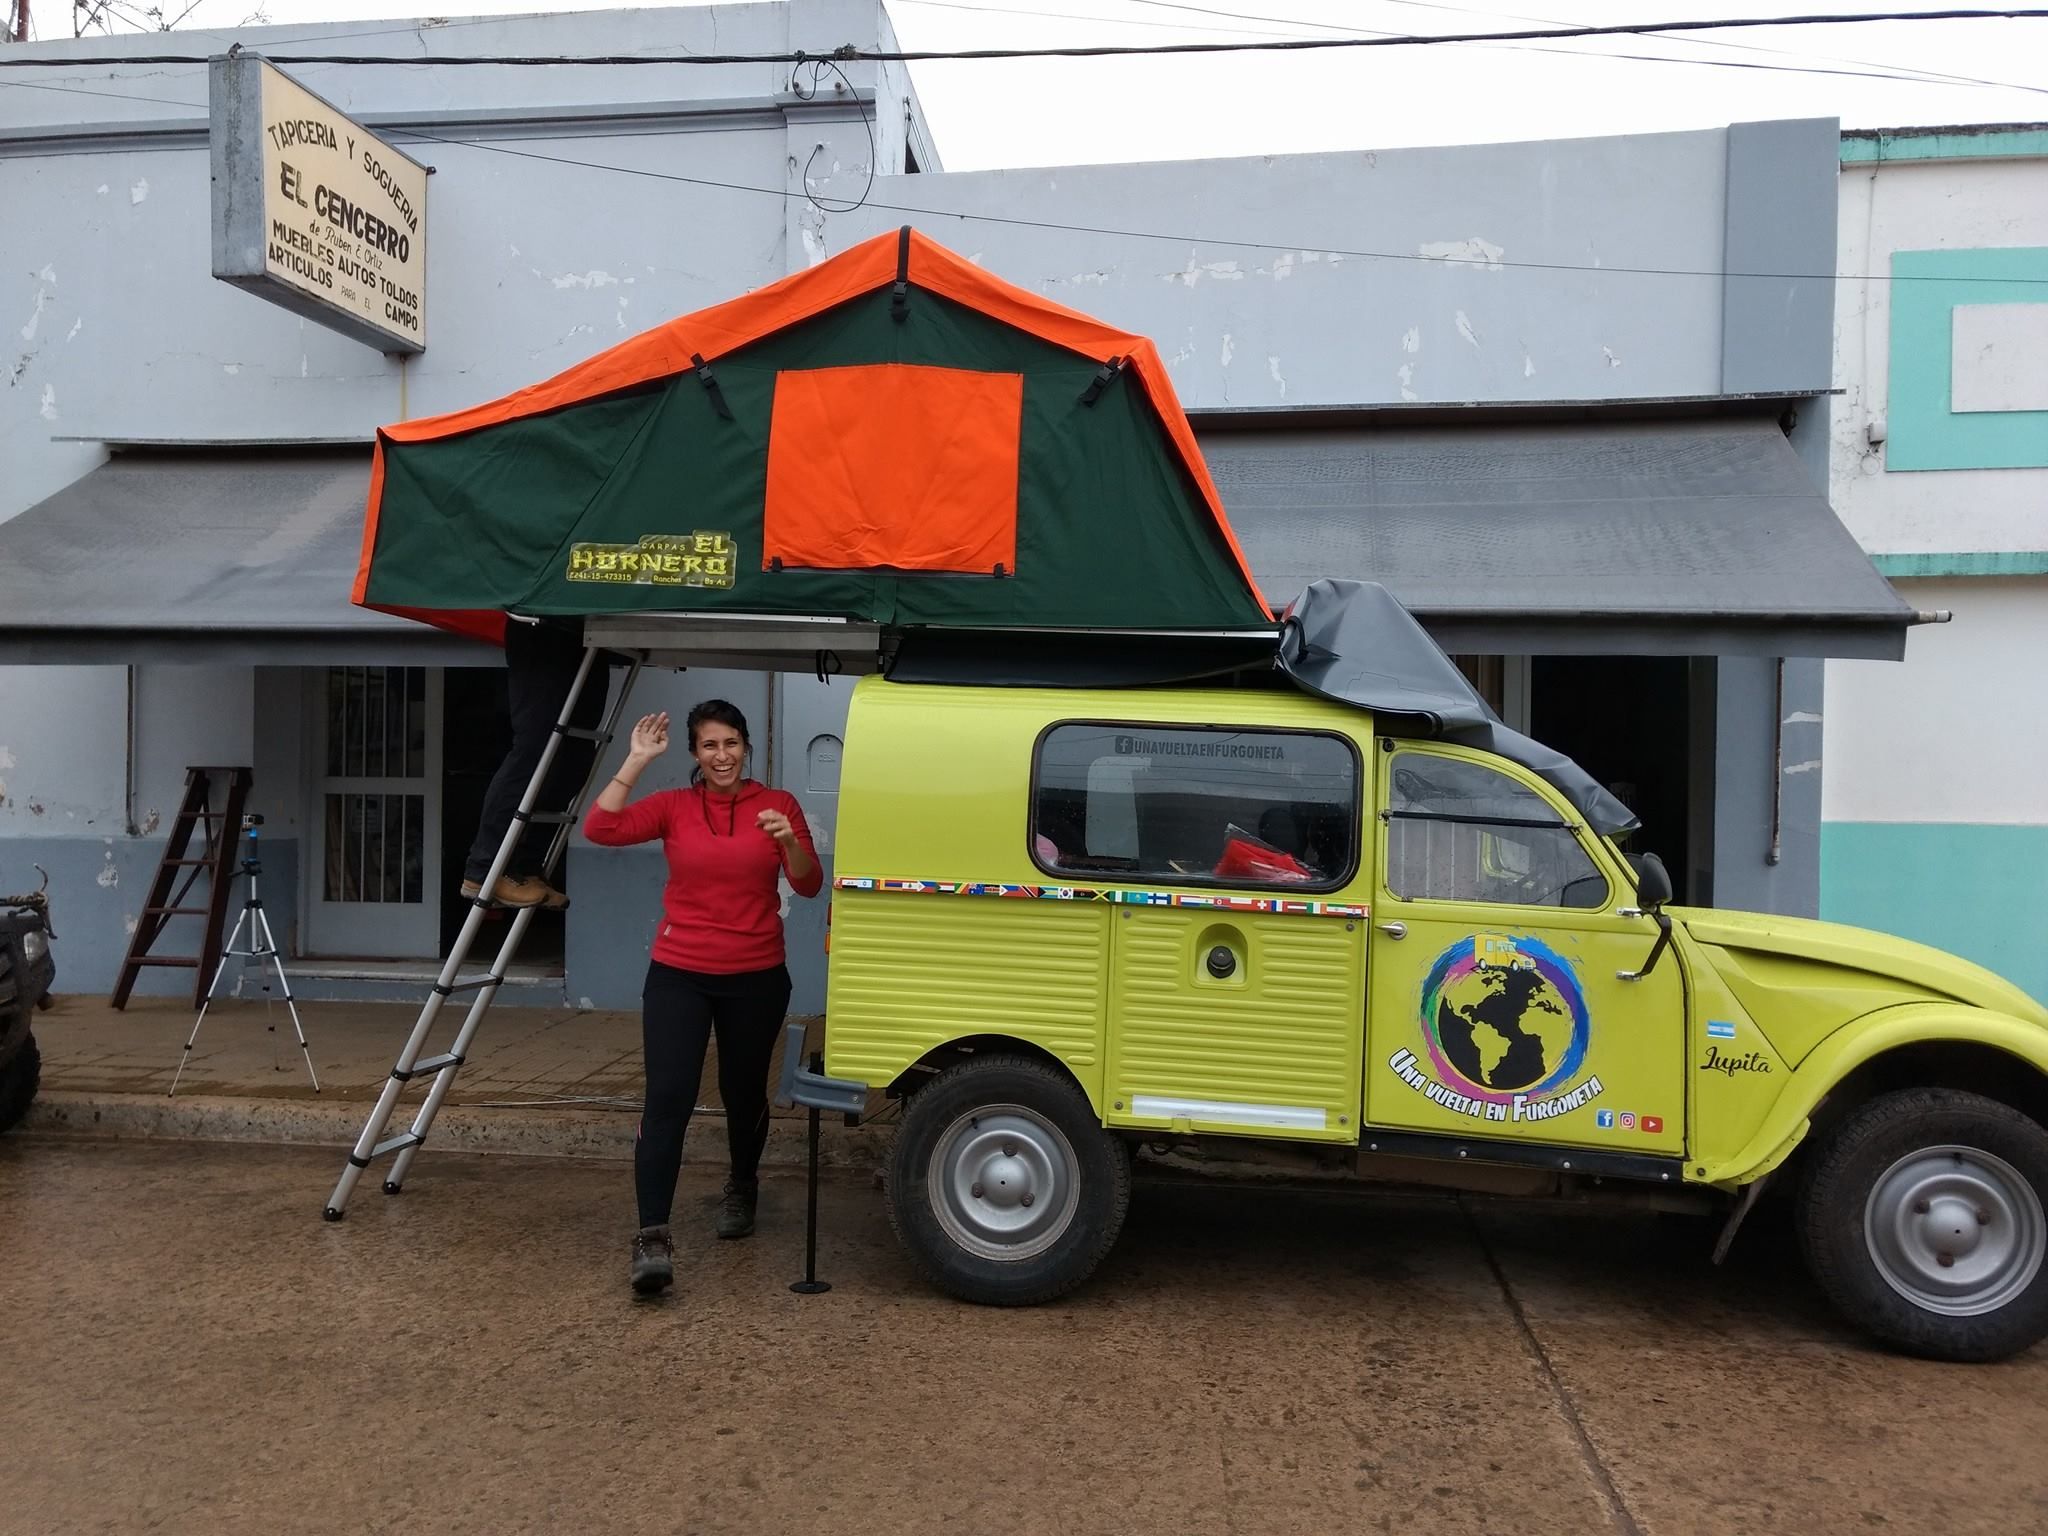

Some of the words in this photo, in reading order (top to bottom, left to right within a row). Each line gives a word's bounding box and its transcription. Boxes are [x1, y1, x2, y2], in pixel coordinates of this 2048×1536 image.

[267, 119, 338, 152] TAPICERIA
[346, 136, 355, 160] Y
[363, 151, 418, 235] SOGUERIA
[280, 161, 308, 209] EL
[314, 184, 409, 264] CENCERRO
[272, 218, 335, 267] MUEBLES
[338, 255, 376, 289] AUTOS
[379, 276, 418, 311] TOLDOS
[309, 219, 321, 236] de
[364, 249, 383, 271] Ortiz
[268, 242, 333, 289] ARTICULOS
[340, 285, 356, 302] PARA
[364, 297, 372, 310] EL
[385, 302, 418, 332] CAMPO
[571, 550, 728, 576] HORNERO
[641, 542, 687, 551] CARPAS
[693, 534, 729, 555] EL
[1133, 740, 1285, 760] UNAVUELTAENFURGONETA
[1700, 1046, 1773, 1077] Lupita
